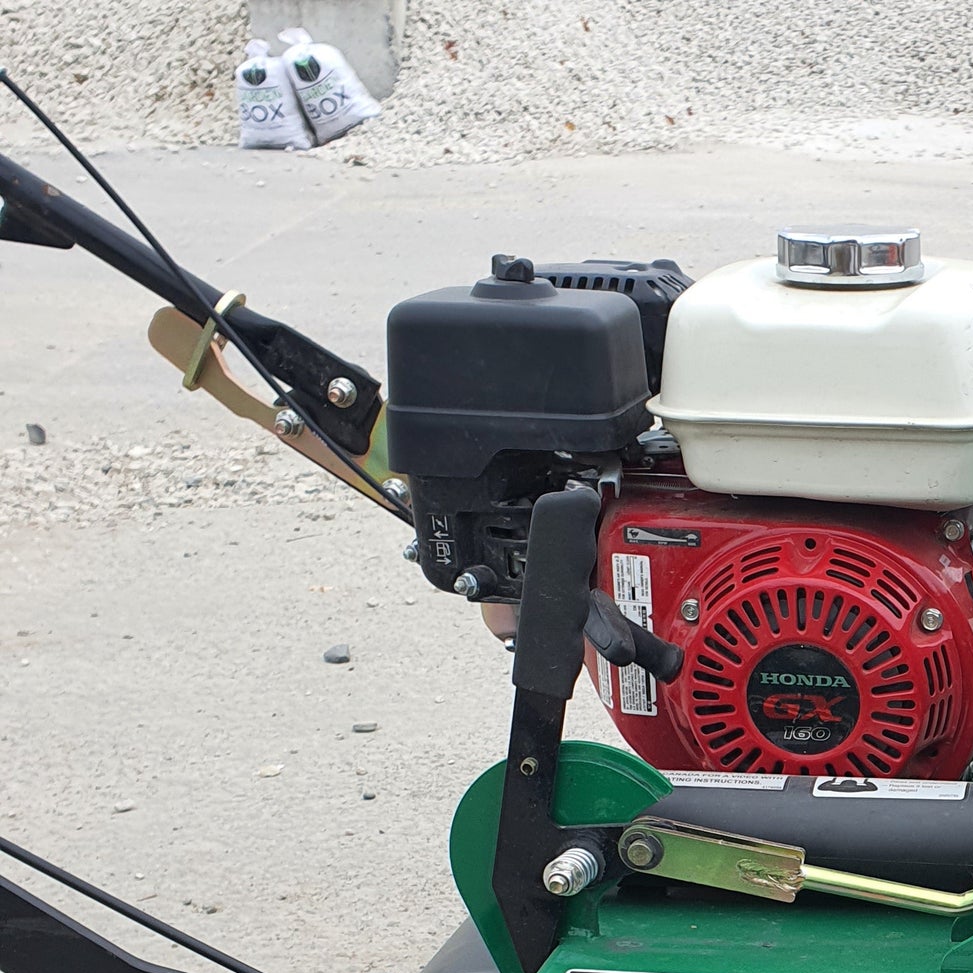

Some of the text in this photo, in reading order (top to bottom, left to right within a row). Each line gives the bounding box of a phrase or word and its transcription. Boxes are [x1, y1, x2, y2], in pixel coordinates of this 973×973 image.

[760, 672, 851, 688] HONDA
[762, 693, 847, 723] GX
[783, 726, 831, 741] 160
